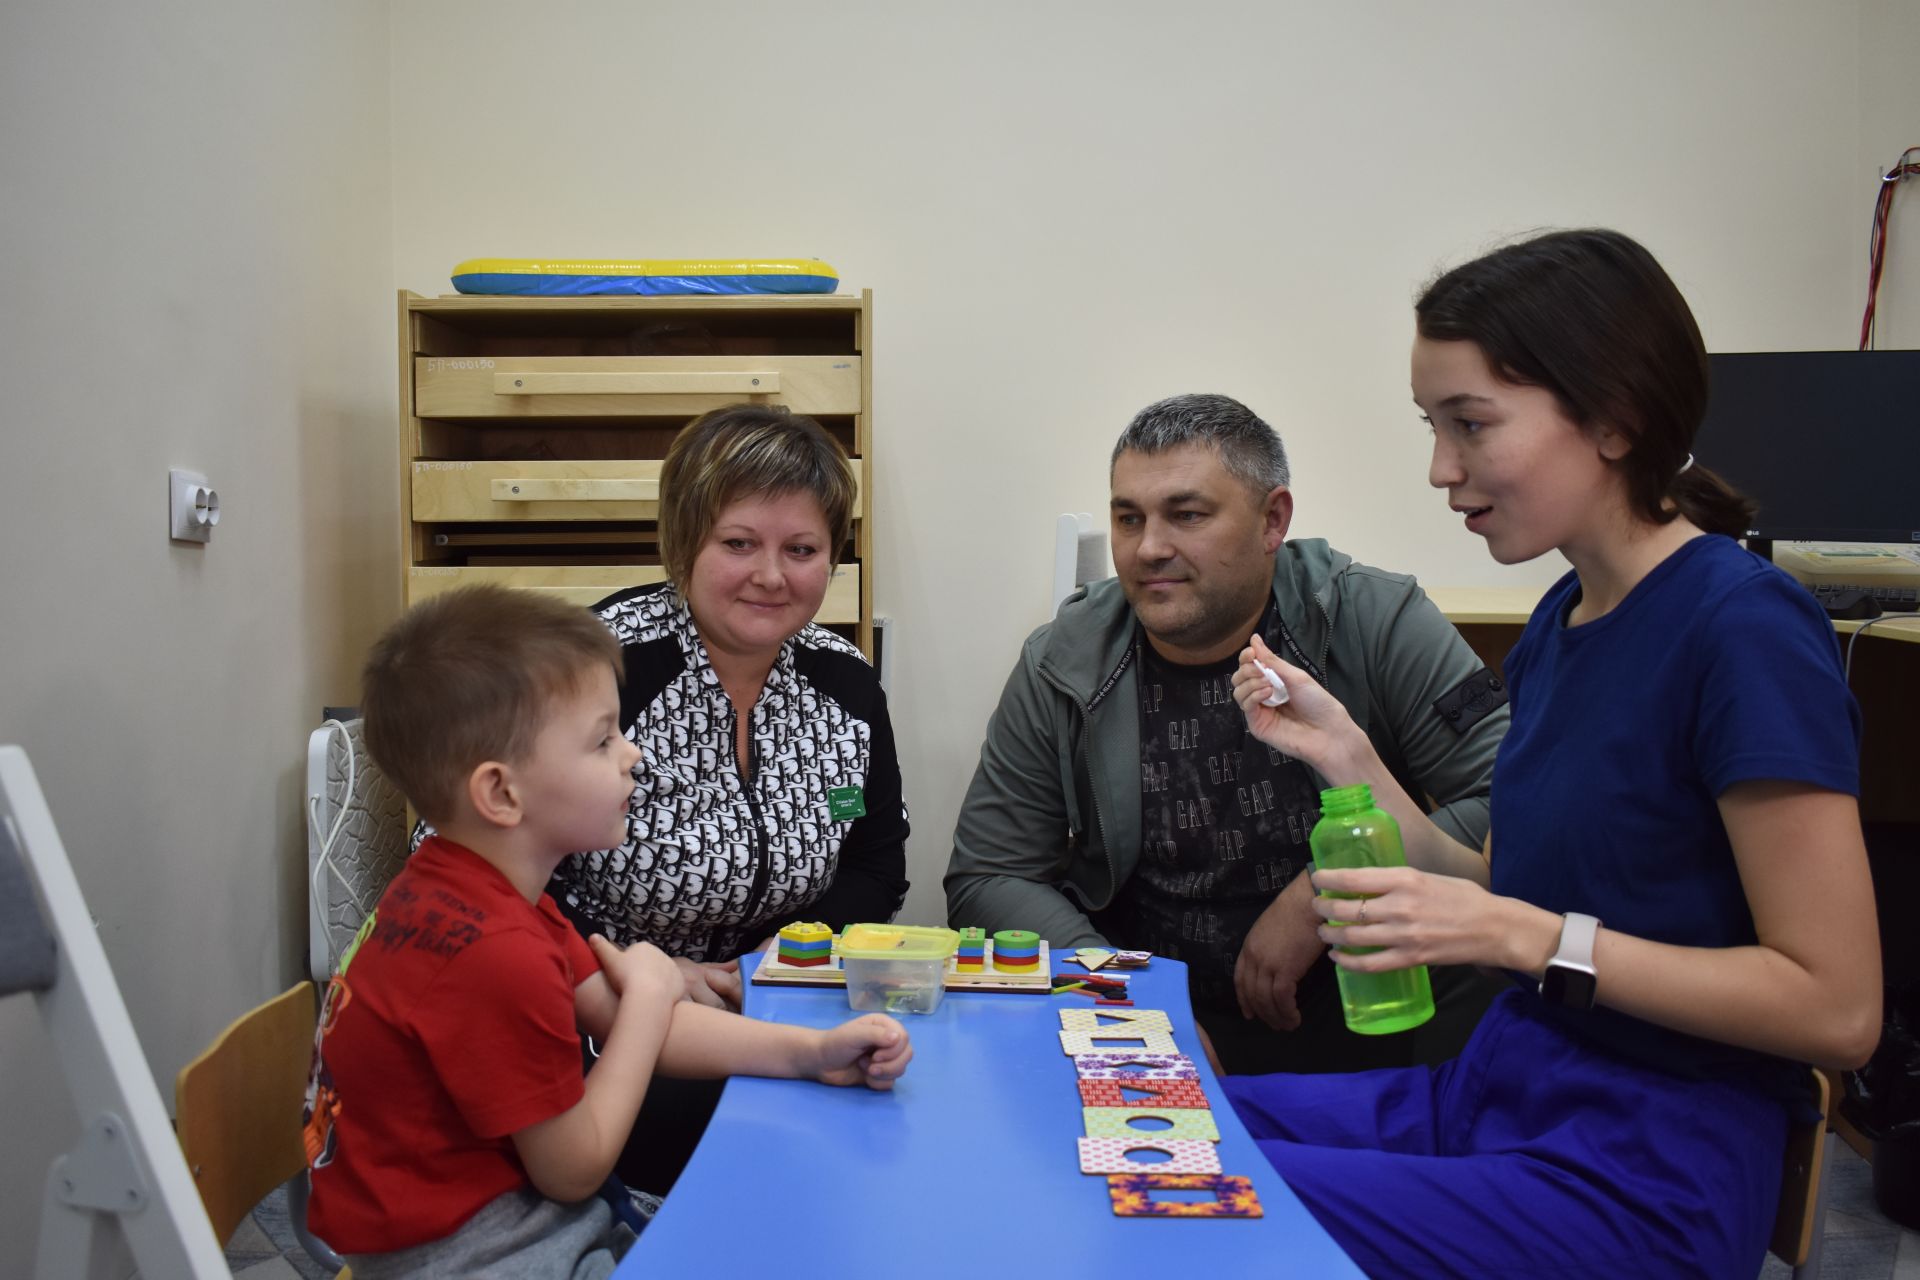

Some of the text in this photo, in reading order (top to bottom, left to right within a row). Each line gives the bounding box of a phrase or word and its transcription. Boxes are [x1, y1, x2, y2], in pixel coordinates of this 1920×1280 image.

[1169, 718, 1200, 750] GAP
[1141, 761, 1169, 793] GAP
[1208, 752, 1242, 785] GAP
[1176, 797, 1211, 829] GAP
[1237, 780, 1274, 817] GAP
[1287, 808, 1318, 845] GA
[1182, 911, 1218, 943] GAP
